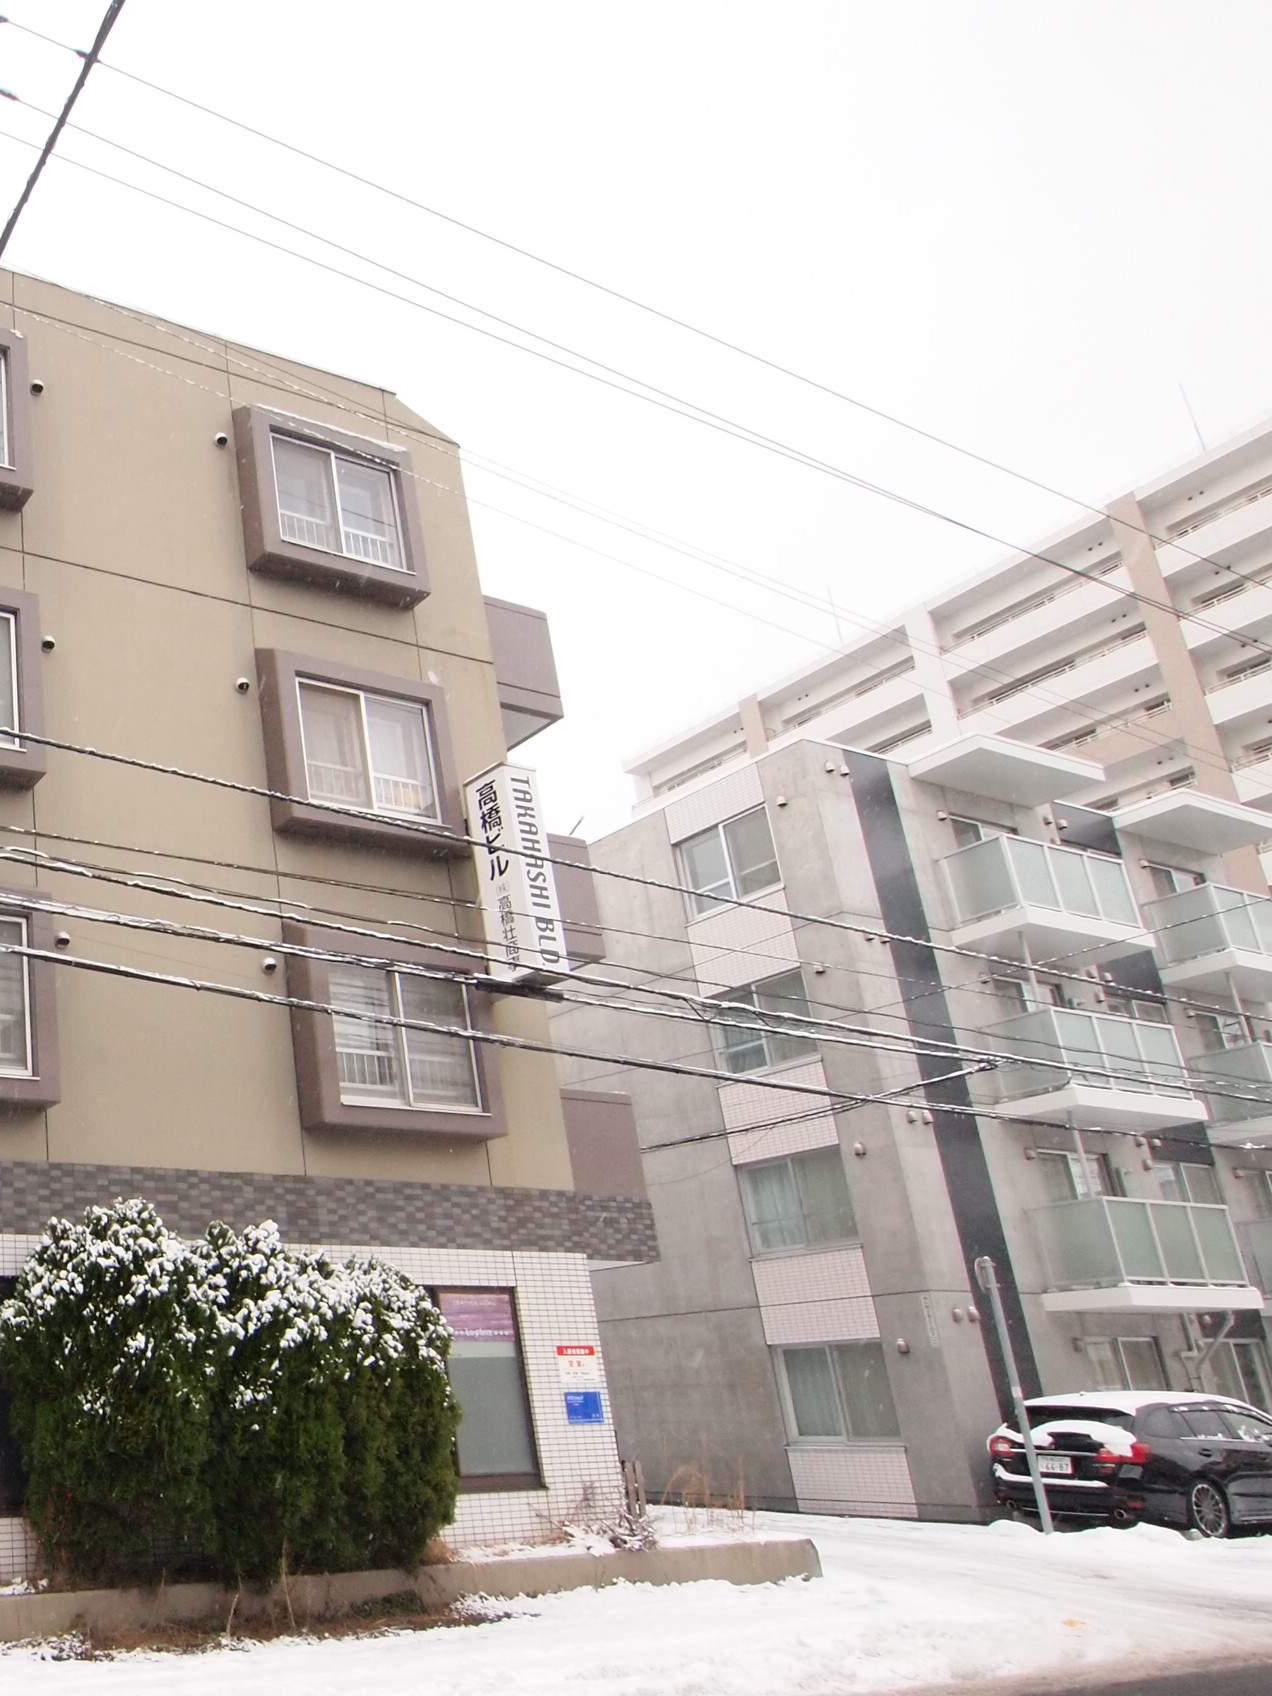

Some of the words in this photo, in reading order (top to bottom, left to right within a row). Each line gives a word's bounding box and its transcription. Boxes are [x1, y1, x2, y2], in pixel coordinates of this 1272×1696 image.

[475, 779, 509, 881] 高橋ビル
[510, 776, 552, 909] TAKAHASHI
